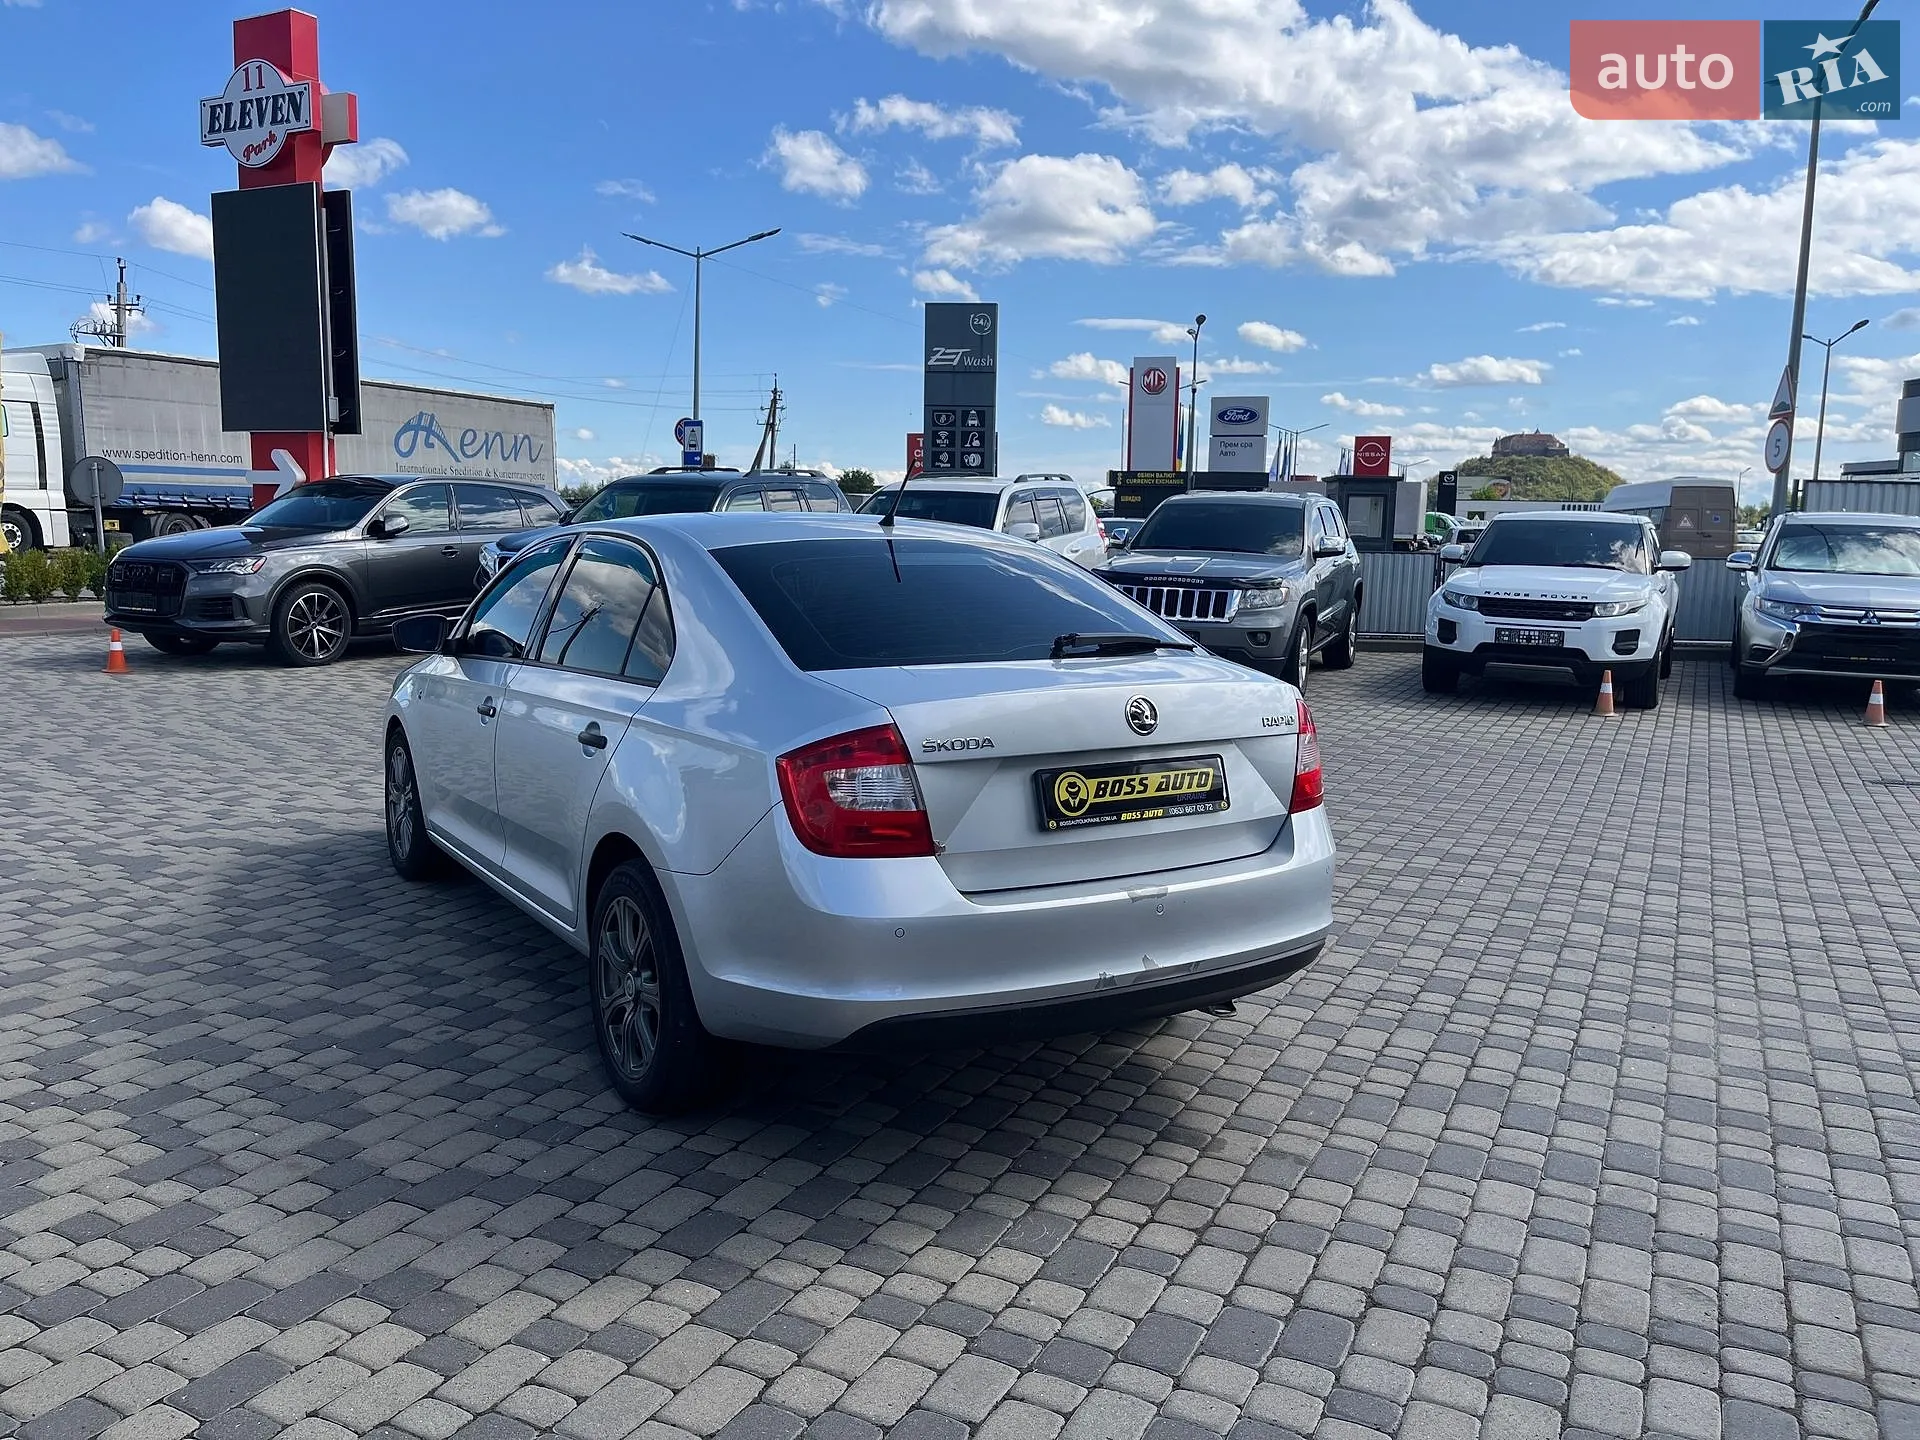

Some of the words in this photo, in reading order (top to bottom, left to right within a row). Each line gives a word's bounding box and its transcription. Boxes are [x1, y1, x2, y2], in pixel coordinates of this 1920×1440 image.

[242, 64, 266, 92] 11
[207, 91, 305, 135] ELEVEN
[242, 130, 278, 162] Park
[928, 347, 971, 366] ZET
[963, 355, 993, 367] Wash
[1143, 371, 1165, 388] MG
[1223, 409, 1250, 422] Ford
[393, 410, 544, 463] Henn
[102, 448, 243, 464] www.spedition-henn.com
[1219, 449, 1236, 457] Авто
[1774, 439, 1781, 458] 5
[395, 462, 447, 475] Internationale
[449, 465, 484, 477] Spedition
[484, 468, 491, 477] &
[1093, 776, 1149, 799] BOSS
[1155, 770, 1211, 793] AUTO
[1176, 792, 1207, 802] UKRAINE
[1121, 812, 1142, 821] BOSS
[1142, 809, 1164, 818] AUTO
[1196, 804, 1205, 812] 02
[1205, 803, 1214, 811] 72
